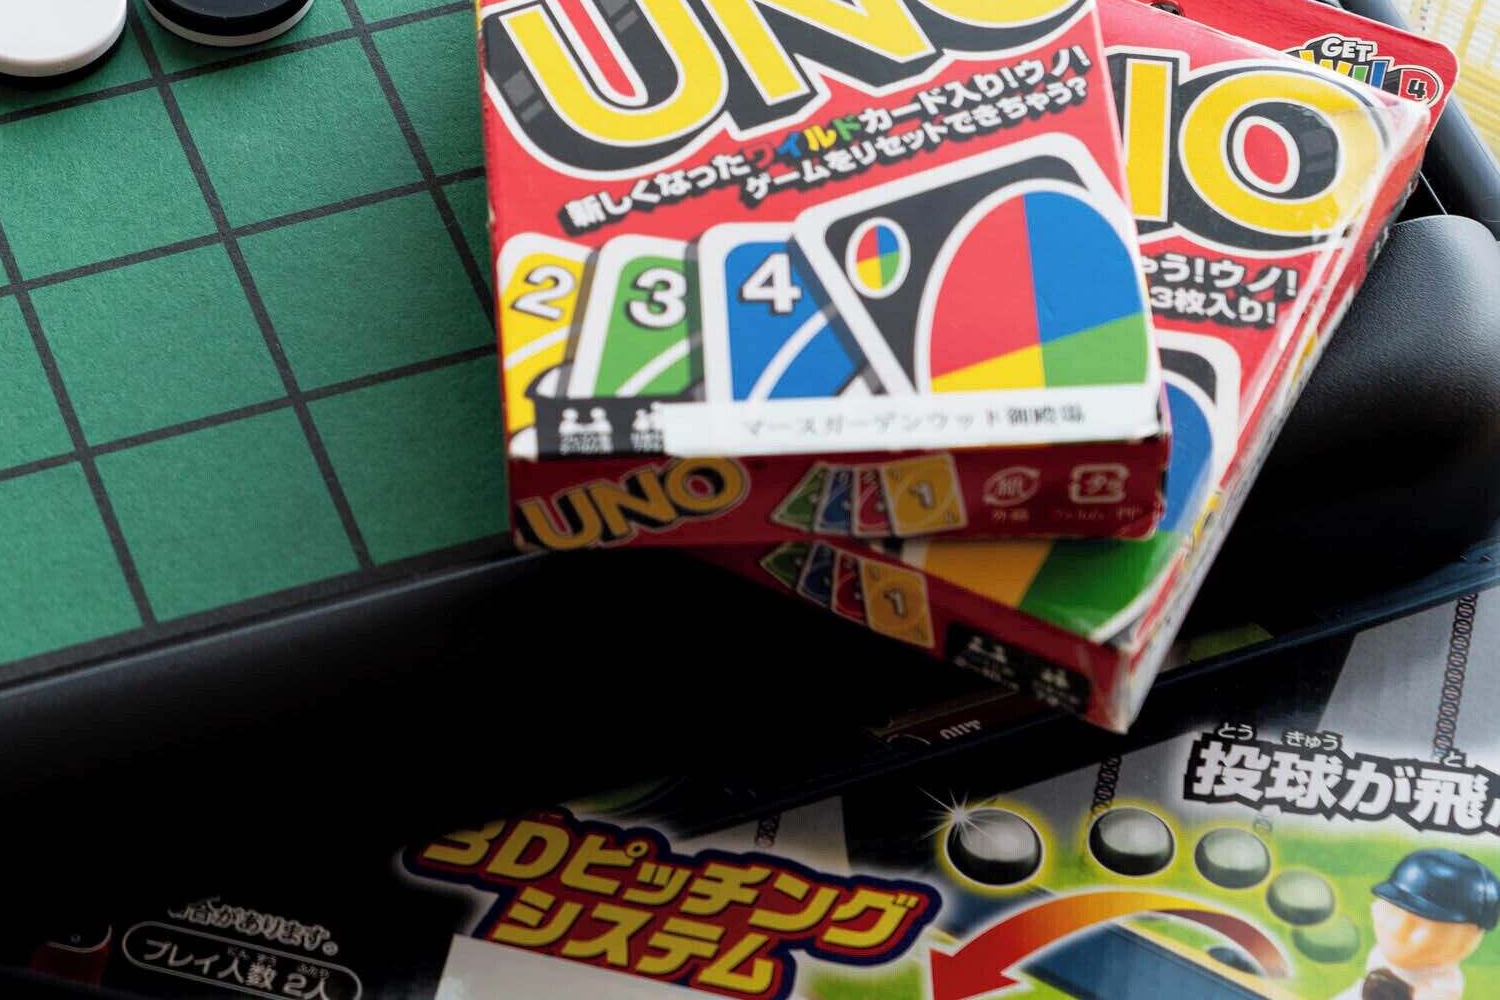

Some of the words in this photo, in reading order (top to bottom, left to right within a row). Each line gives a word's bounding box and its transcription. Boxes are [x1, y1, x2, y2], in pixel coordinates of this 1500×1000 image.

[1321, 37, 1373, 63] GET
[1407, 79, 1428, 101] 4
[746, 76, 1088, 200] ゲームをリセットできちゃう?
[511, 264, 576, 321] 2
[626, 267, 688, 329] 3
[740, 252, 803, 314] 4
[516, 457, 748, 550] UNO
[912, 482, 933, 509] 1
[1217, 723, 1255, 740] とう
[1285, 731, 1341, 752] きゅう
[142, 937, 277, 990] プレイ人数
[492, 886, 776, 994] システム
